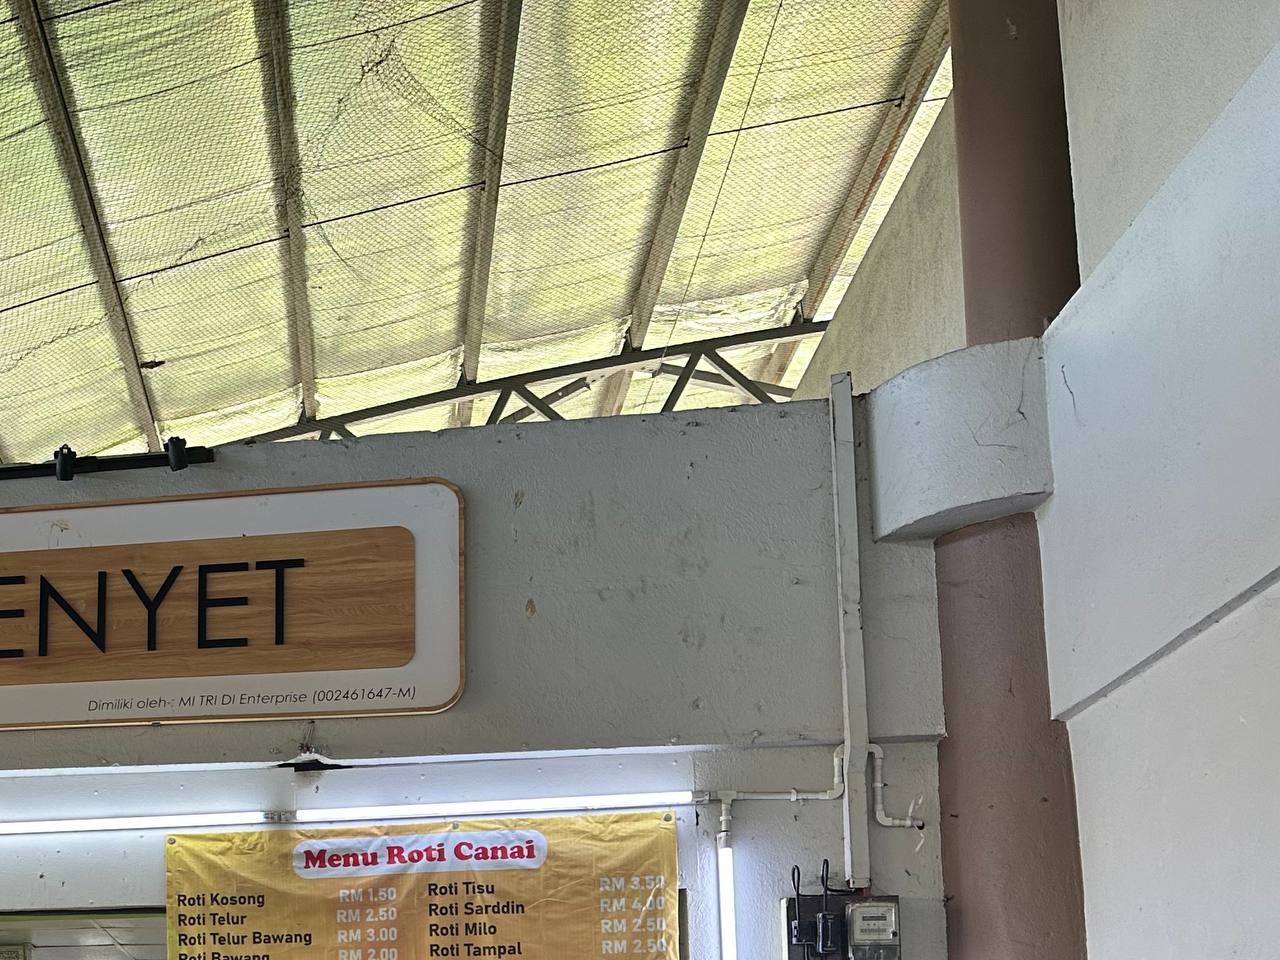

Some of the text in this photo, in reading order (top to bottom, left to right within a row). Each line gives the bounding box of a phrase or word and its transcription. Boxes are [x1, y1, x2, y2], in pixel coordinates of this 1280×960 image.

[88, 699, 133, 712] Dimiliki
[178, 696, 195, 707] MI
[199, 695, 217, 706] TRI
[221, 694, 235, 705] DI
[240, 692, 307, 706] Enterprise
[312, 686, 416, 704] (002461647-M)
[303, 839, 536, 869] Menu Roti Canai
[428, 876, 664, 896] Roti Tisu RM 3.50
[177, 887, 396, 908] Roti Kosong RM 1.50
[428, 903, 458, 917] Roti
[464, 901, 525, 915] Sarddin
[600, 898, 626, 912] RM
[178, 907, 397, 926] Roti Telur RM 2.50
[178, 928, 397, 946] Roti Telur Bawang RM 3.00
[429, 918, 666, 937] Roti Milo RM 2.50
[429, 938, 667, 958] Roti Tampal RM 2.50
